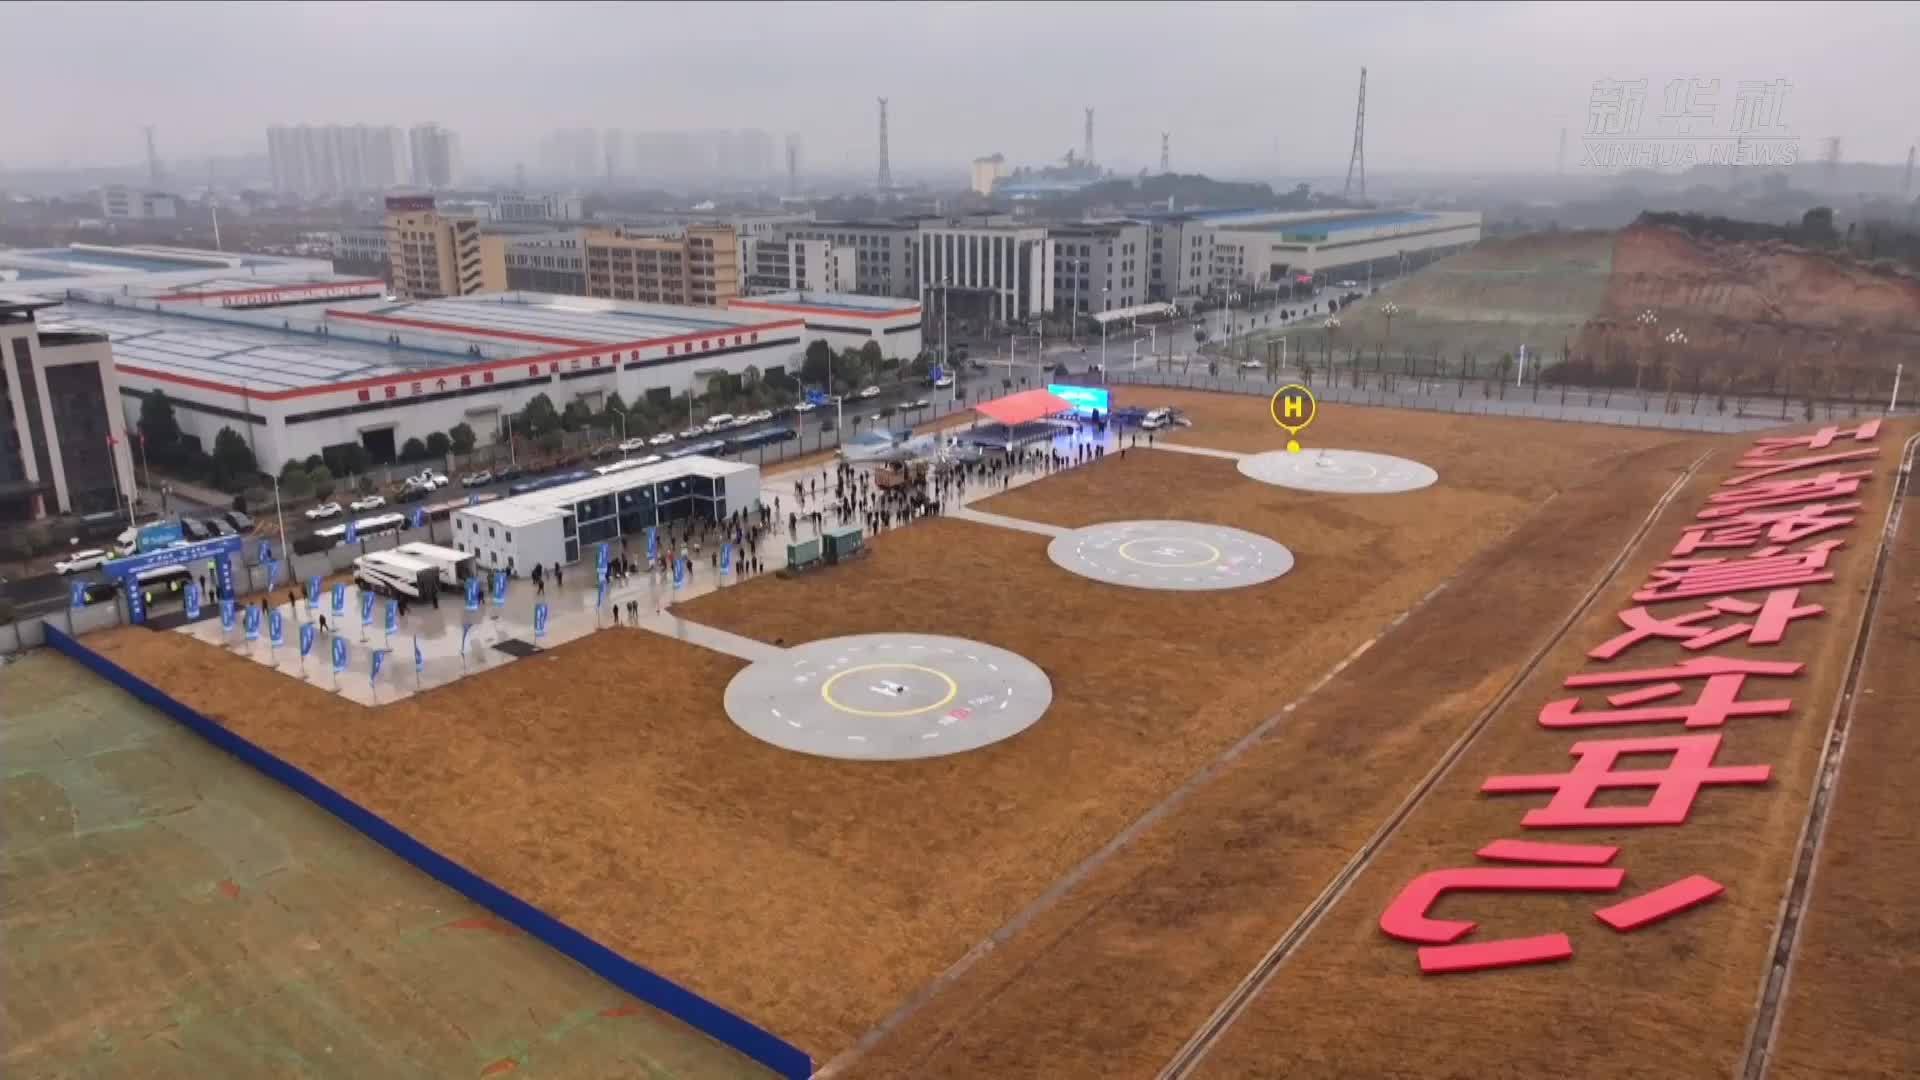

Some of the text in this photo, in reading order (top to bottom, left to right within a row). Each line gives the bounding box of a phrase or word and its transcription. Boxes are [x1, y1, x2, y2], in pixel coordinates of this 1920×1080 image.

[1379, 419, 1882, 973] 无人机检测交付中心
